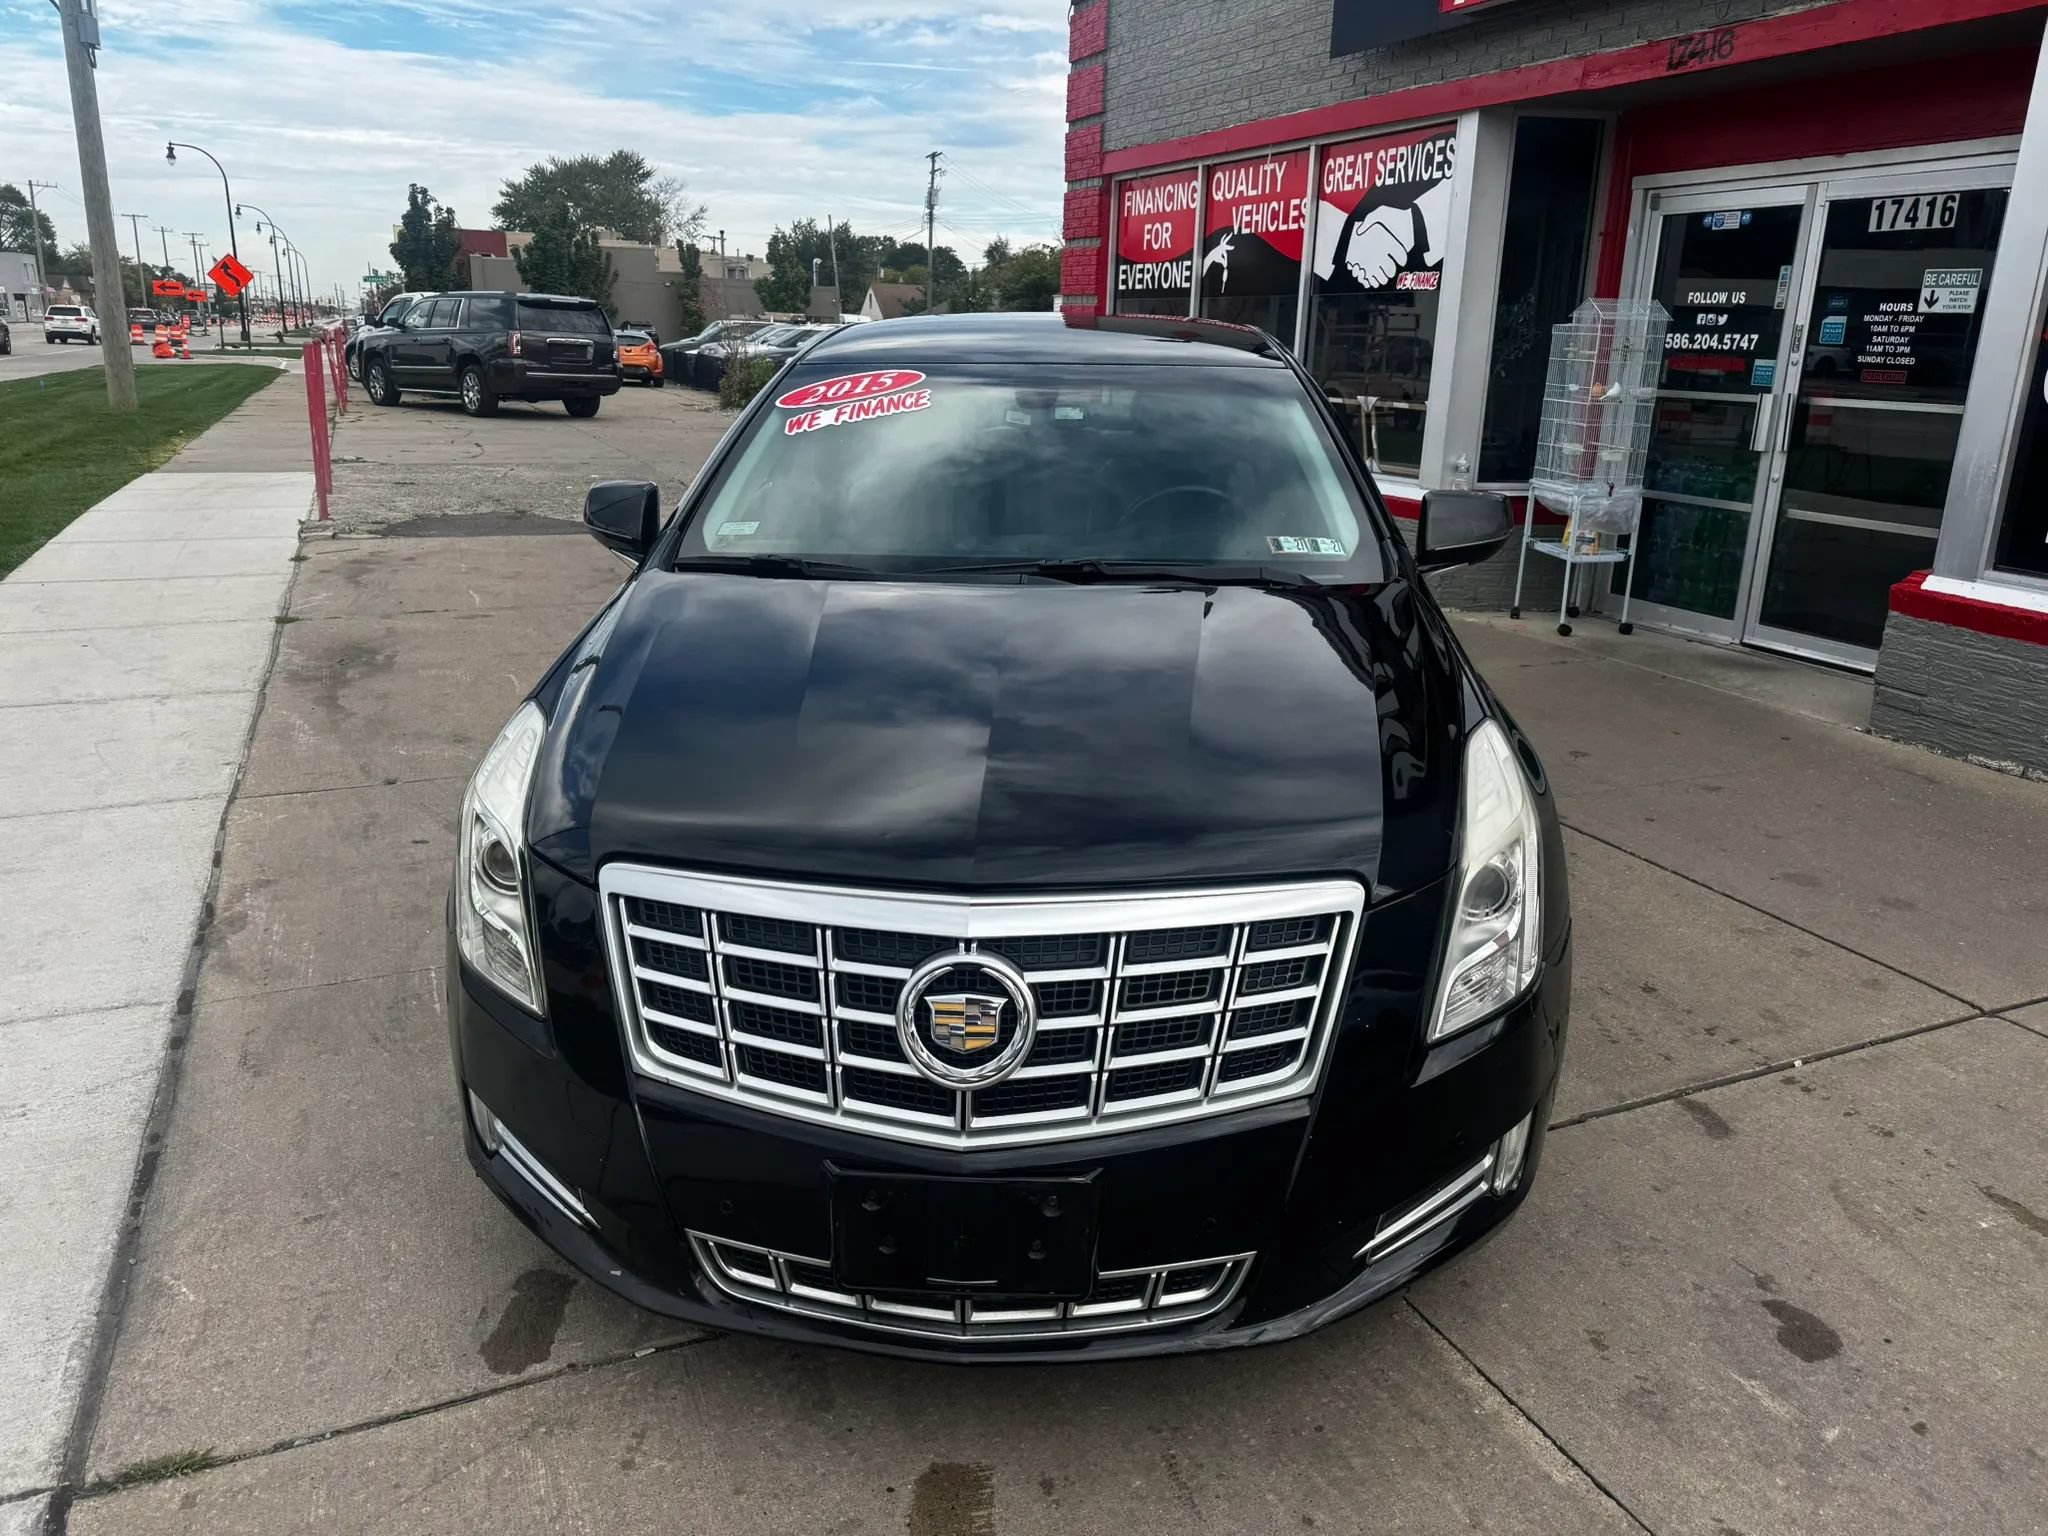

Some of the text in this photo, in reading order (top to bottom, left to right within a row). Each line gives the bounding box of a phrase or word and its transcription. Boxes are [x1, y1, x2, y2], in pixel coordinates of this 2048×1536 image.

[1666, 31, 1735, 71] 17416
[1324, 137, 1456, 194] GREAT SERVICES
[1212, 161, 1287, 202] QUALITY
[1124, 180, 1198, 217] FINANCING
[1875, 195, 1957, 230] 17416
[1232, 197, 1309, 235] VEHICLES
[1144, 222, 1172, 250] FOR
[1118, 261, 1192, 290] EVERYONE
[1925, 273, 1978, 285] BE CAREFUL
[1688, 292, 1746, 304] FOLLOW US
[1879, 303, 1913, 311] HOURS
[1898, 315, 1925, 323] FRIDAY
[1900, 325, 1916, 333] 6PM
[1664, 333, 1759, 350] 586.204.5747
[1866, 345, 1883, 353] 11AM
[1886, 356, 1916, 365] CLOSED
[801, 372, 899, 405] 2015
[787, 390, 931, 434] WE FINANCE
